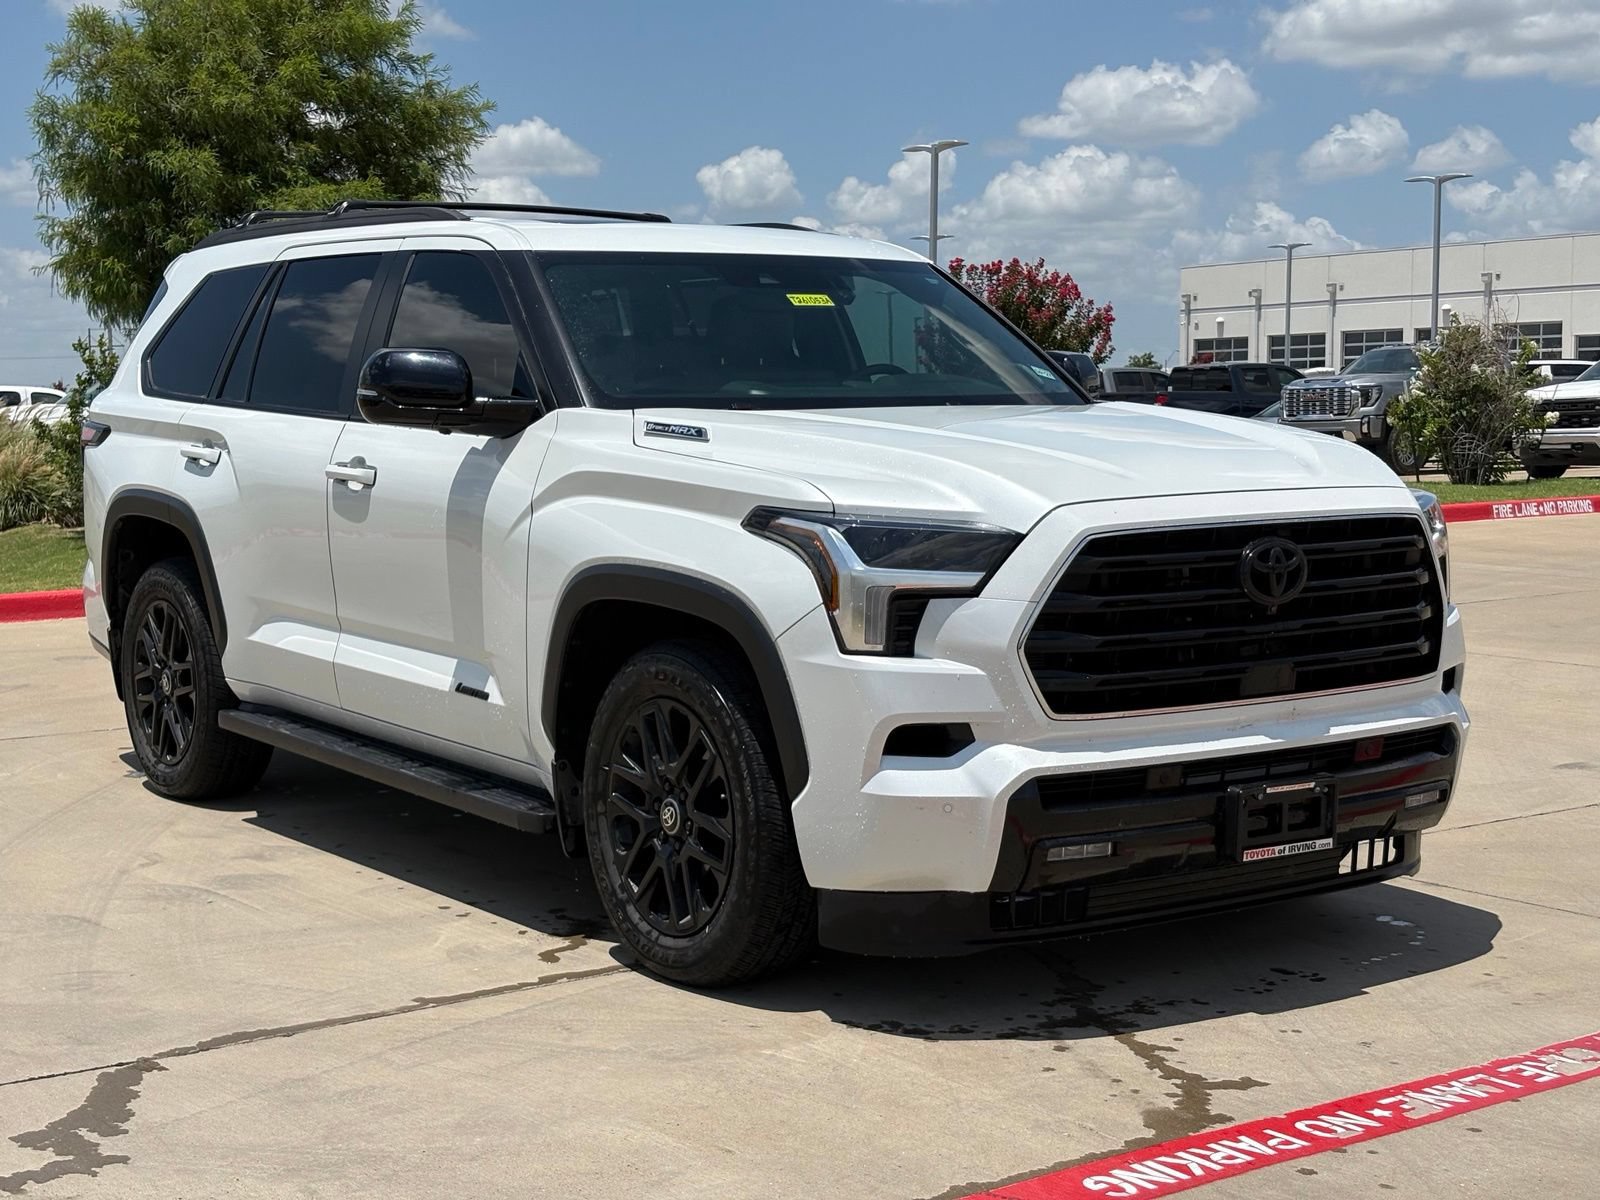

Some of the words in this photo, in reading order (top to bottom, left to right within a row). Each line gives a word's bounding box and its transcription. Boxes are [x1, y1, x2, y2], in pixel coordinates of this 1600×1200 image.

[668, 425, 698, 435] MAX
[1492, 504, 1514, 518] FIRE
[1515, 502, 1540, 516] LANE
[1543, 501, 1556, 514] NO
[1557, 499, 1593, 513] PARKING
[1244, 848, 1276, 860] TOYOTA
[1277, 846, 1286, 855] of
[1294, 1110, 1384, 1139] NO
[1082, 1128, 1312, 1197] PARKING
